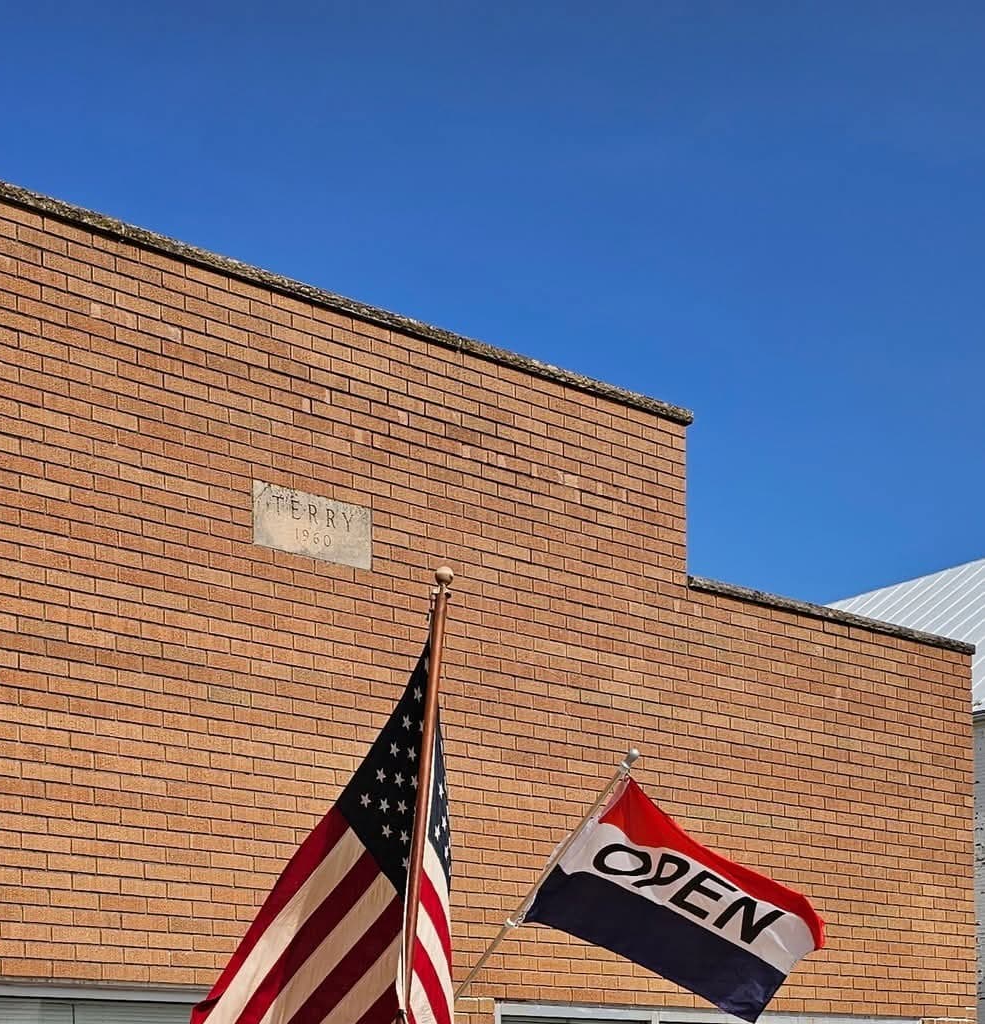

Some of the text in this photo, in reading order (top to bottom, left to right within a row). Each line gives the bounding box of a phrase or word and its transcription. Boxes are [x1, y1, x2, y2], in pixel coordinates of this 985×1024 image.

[272, 495, 354, 533] TERRY
[295, 528, 332, 547] 1960
[592, 842, 787, 945] OPEN
